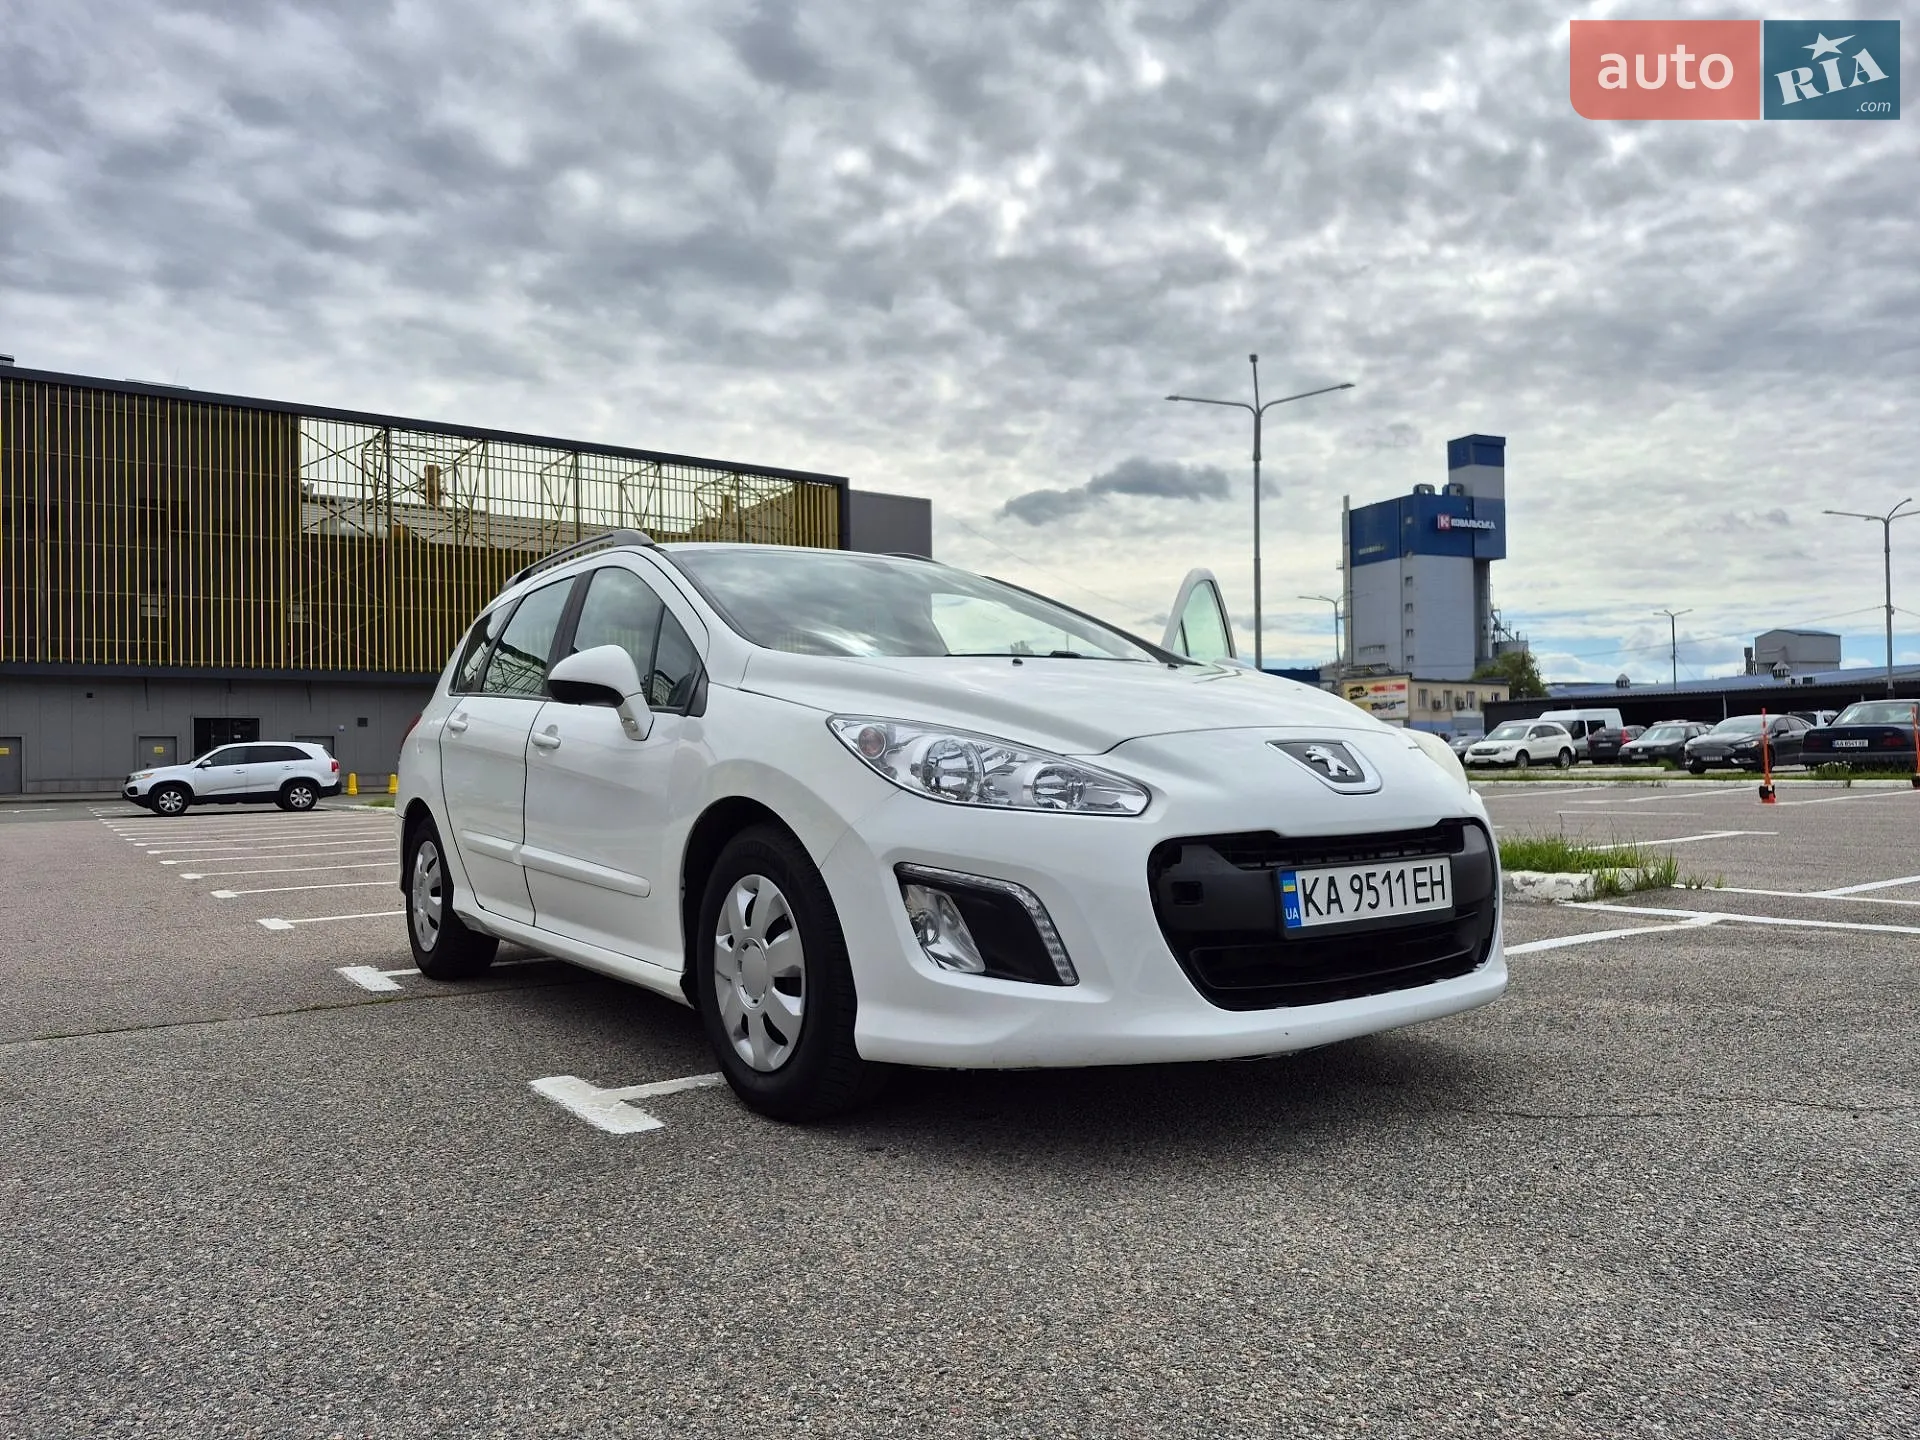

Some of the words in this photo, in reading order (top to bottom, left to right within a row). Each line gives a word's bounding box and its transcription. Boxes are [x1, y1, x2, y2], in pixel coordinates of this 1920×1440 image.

[1301, 876, 1344, 917] KA
[1349, 869, 1407, 912] 9511
[1412, 865, 1446, 904] EH
[1285, 907, 1299, 920] UA
